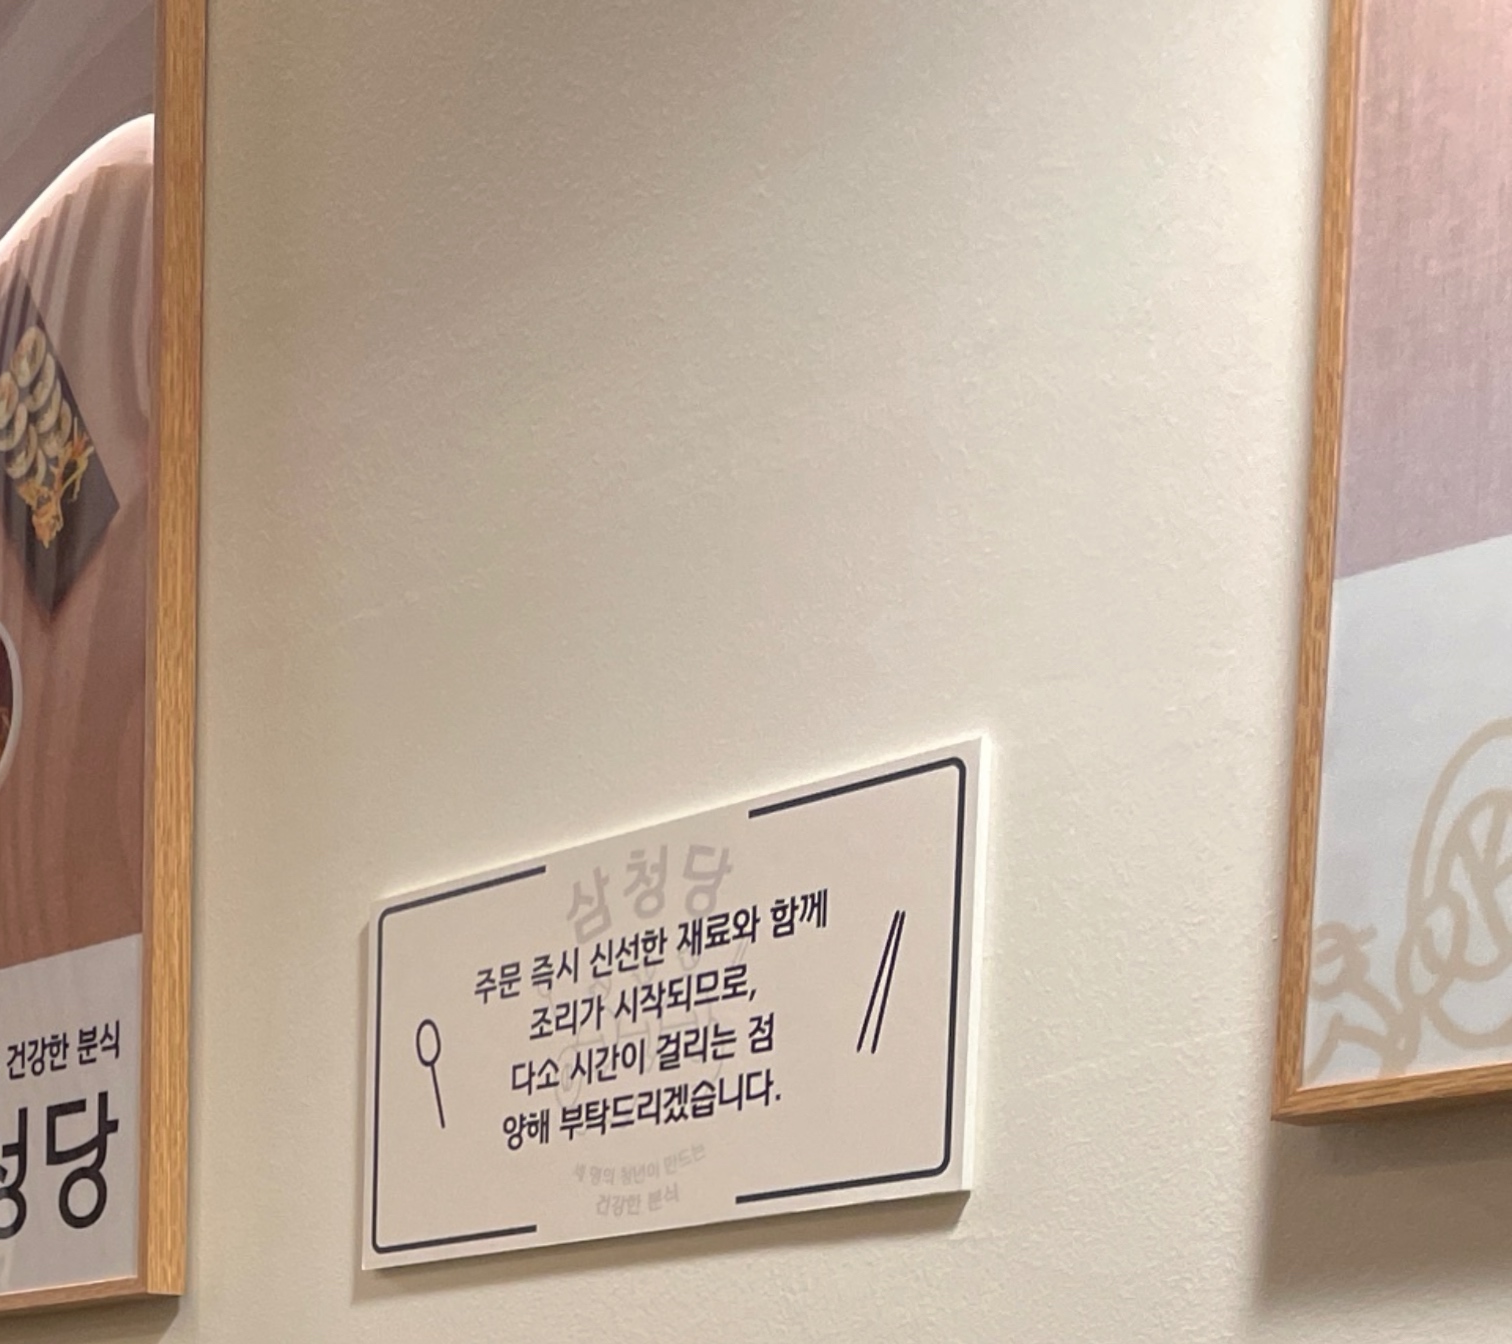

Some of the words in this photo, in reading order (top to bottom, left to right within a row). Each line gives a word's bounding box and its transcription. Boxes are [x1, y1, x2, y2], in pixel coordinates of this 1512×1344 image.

[567, 843, 733, 944] 삼청당
[474, 962, 521, 1004] 주문
[531, 947, 579, 990] 즉시
[590, 927, 668, 979] 신선한
[677, 904, 760, 956] 재료와
[770, 888, 828, 939] 함께
[529, 994, 604, 1040] 조리가
[614, 963, 756, 1023] 시작되므로,
[6, 1032, 69, 1080] 건강한
[77, 1019, 121, 1065] 분식
[511, 1058, 560, 1096] 다소
[570, 1038, 645, 1084] 시간이
[656, 1022, 737, 1071] 걸리는
[748, 1012, 775, 1053] 점
[502, 1108, 550, 1151] 양해
[560, 1068, 781, 1141] 부탁드리겠습니다.
